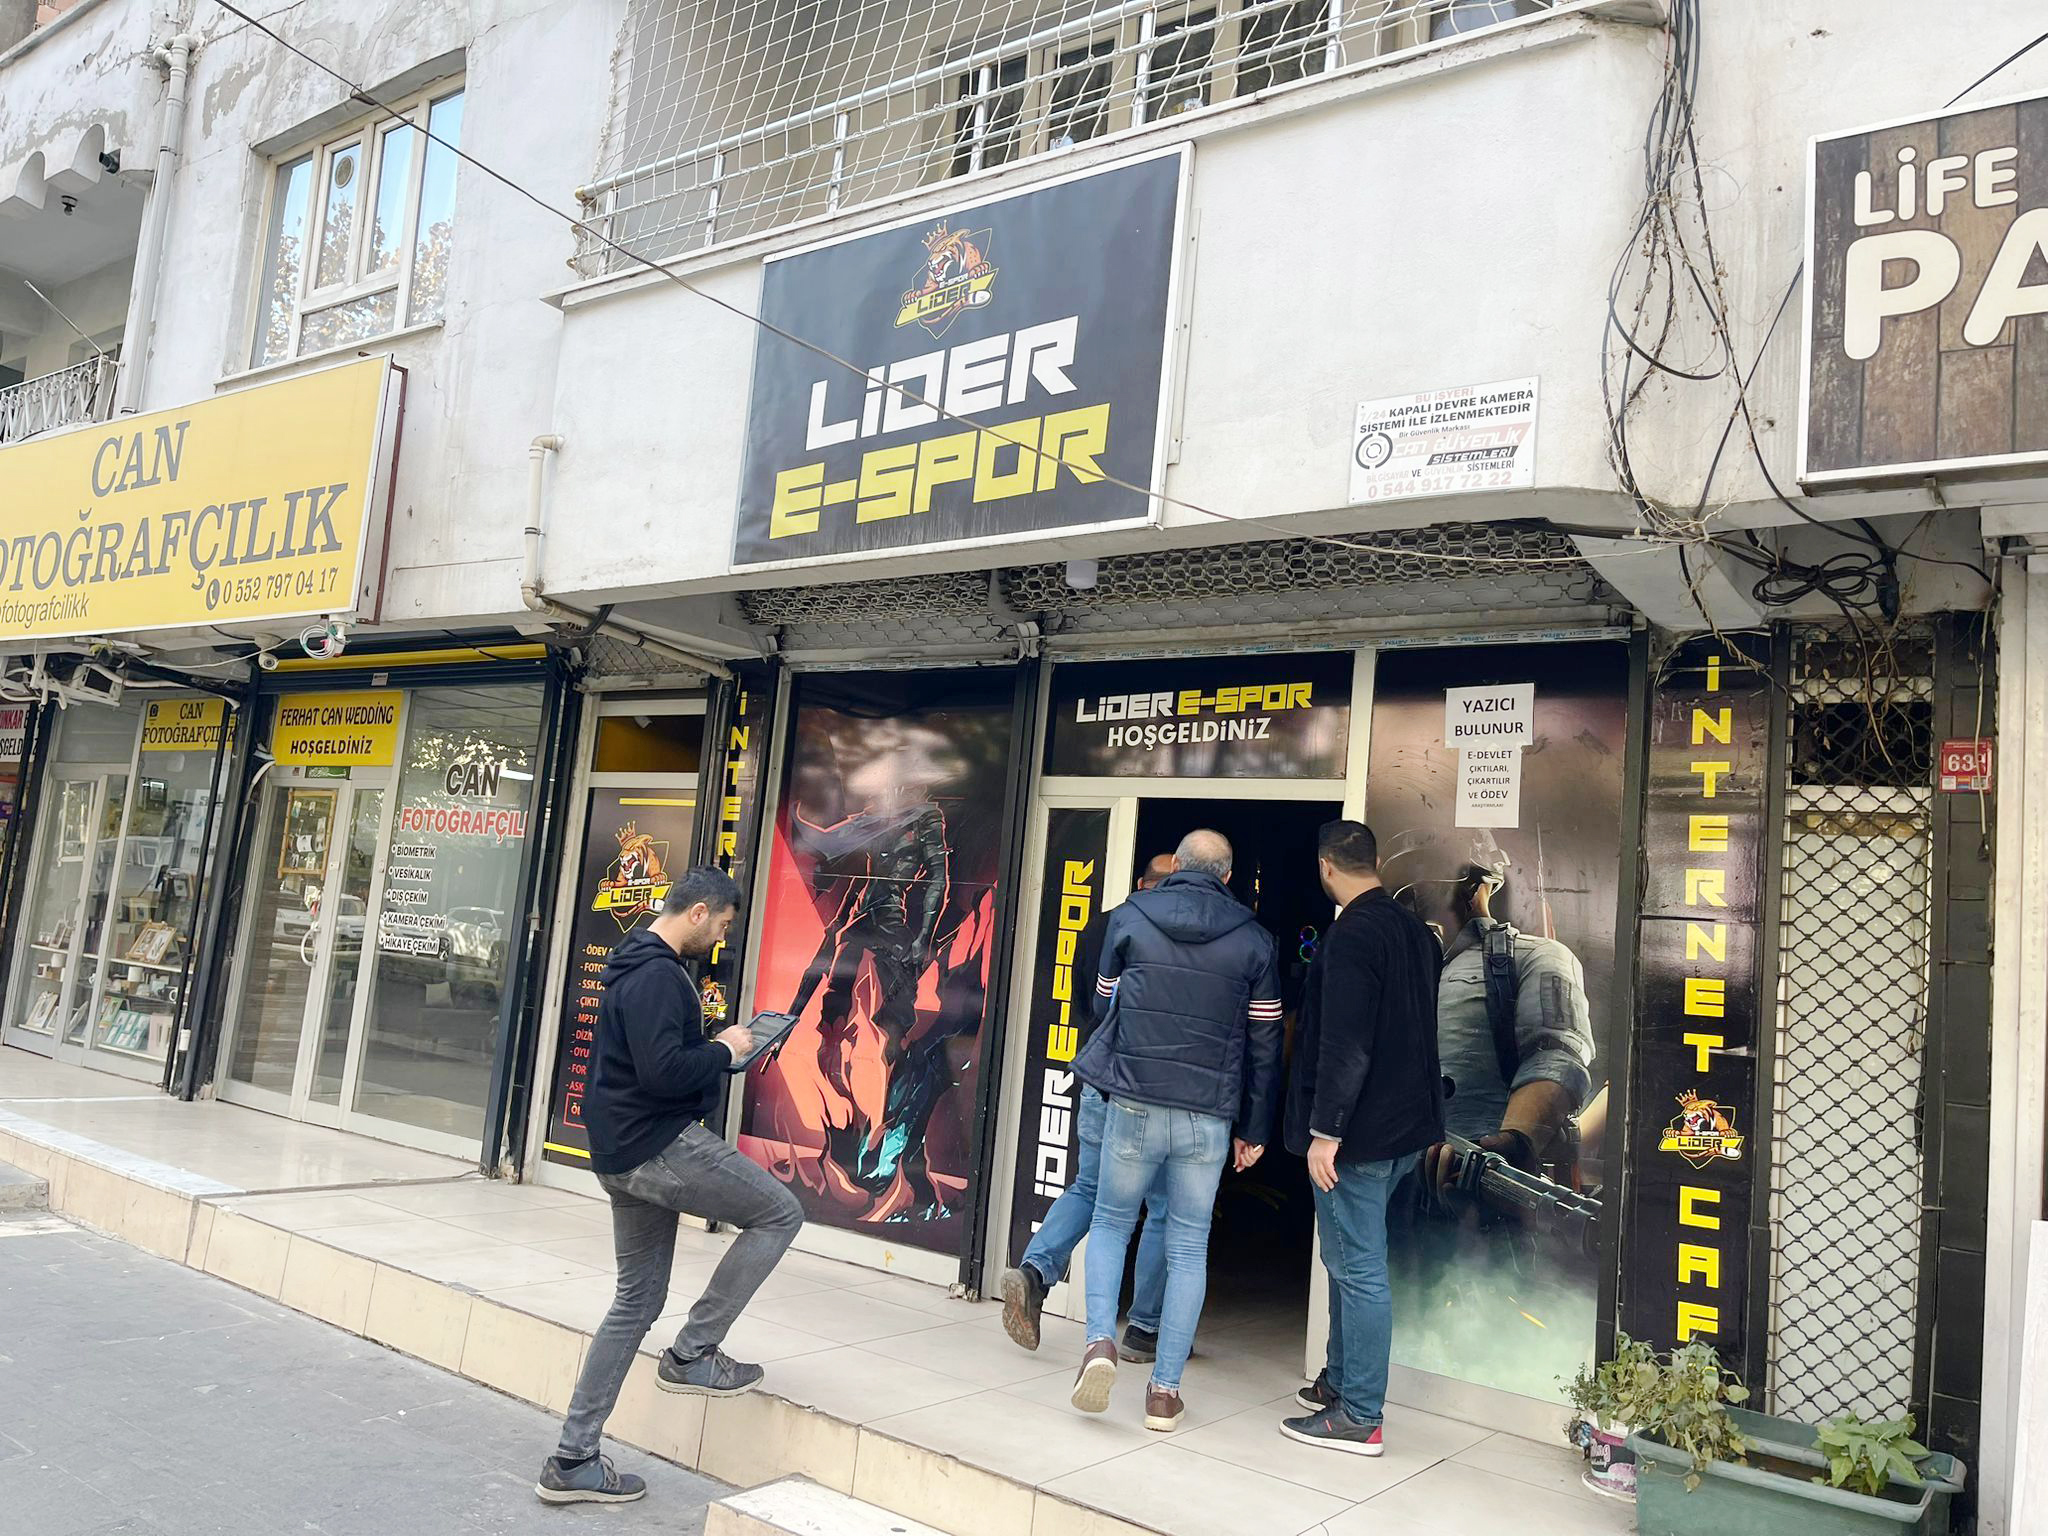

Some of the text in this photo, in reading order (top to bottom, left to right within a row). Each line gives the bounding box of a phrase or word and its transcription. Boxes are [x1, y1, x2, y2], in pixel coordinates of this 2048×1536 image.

[1854, 146, 2019, 227] LİFE
[1389, 403, 1432, 418] KAPALI
[1435, 397, 1477, 412] DEVRE
[1480, 389, 1534, 405] KAMERA
[1415, 387, 1474, 404] BU İŞYERİ
[1360, 401, 1531, 433] SİSTEMİ İLE İZLENMEKTEDİR
[1409, 426, 1440, 437] Güvenlik
[91, 420, 191, 498] CAN
[1411, 469, 1422, 478] VE
[1467, 458, 1515, 473] SİSTEMLERİ
[769, 402, 1111, 540] E-SPOR
[1368, 471, 1512, 499] 0 544 917 72 22
[0, 482, 349, 590] TOĞRAFÇILIK
[223, 566, 339, 604] 0 552 797 04 17
[0, 592, 90, 629] fotografcilikk
[1177, 681, 1313, 716] E-SPOR
[1463, 697, 1516, 714] YAZICI
[180, 703, 204, 720] CAN
[280, 708, 320, 726] FERHAT
[321, 707, 343, 726] CAN
[1455, 721, 1524, 737] BULUNUR
[290, 735, 373, 758] HOŞGELDİNİZ
[1467, 750, 1513, 760] E-DEVLET
[445, 763, 501, 798] CAN
[1467, 777, 1511, 786] ÇIKARTILIR
[1468, 789, 1509, 799] VE ÖDEV
[396, 842, 437, 860] BİOMETRİK
[393, 865, 431, 881] VESİKALIK
[404, 888, 428, 906] ÇEKİM
[387, 913, 418, 928] KAMERA
[1676, 1185, 1722, 1343] CAF
